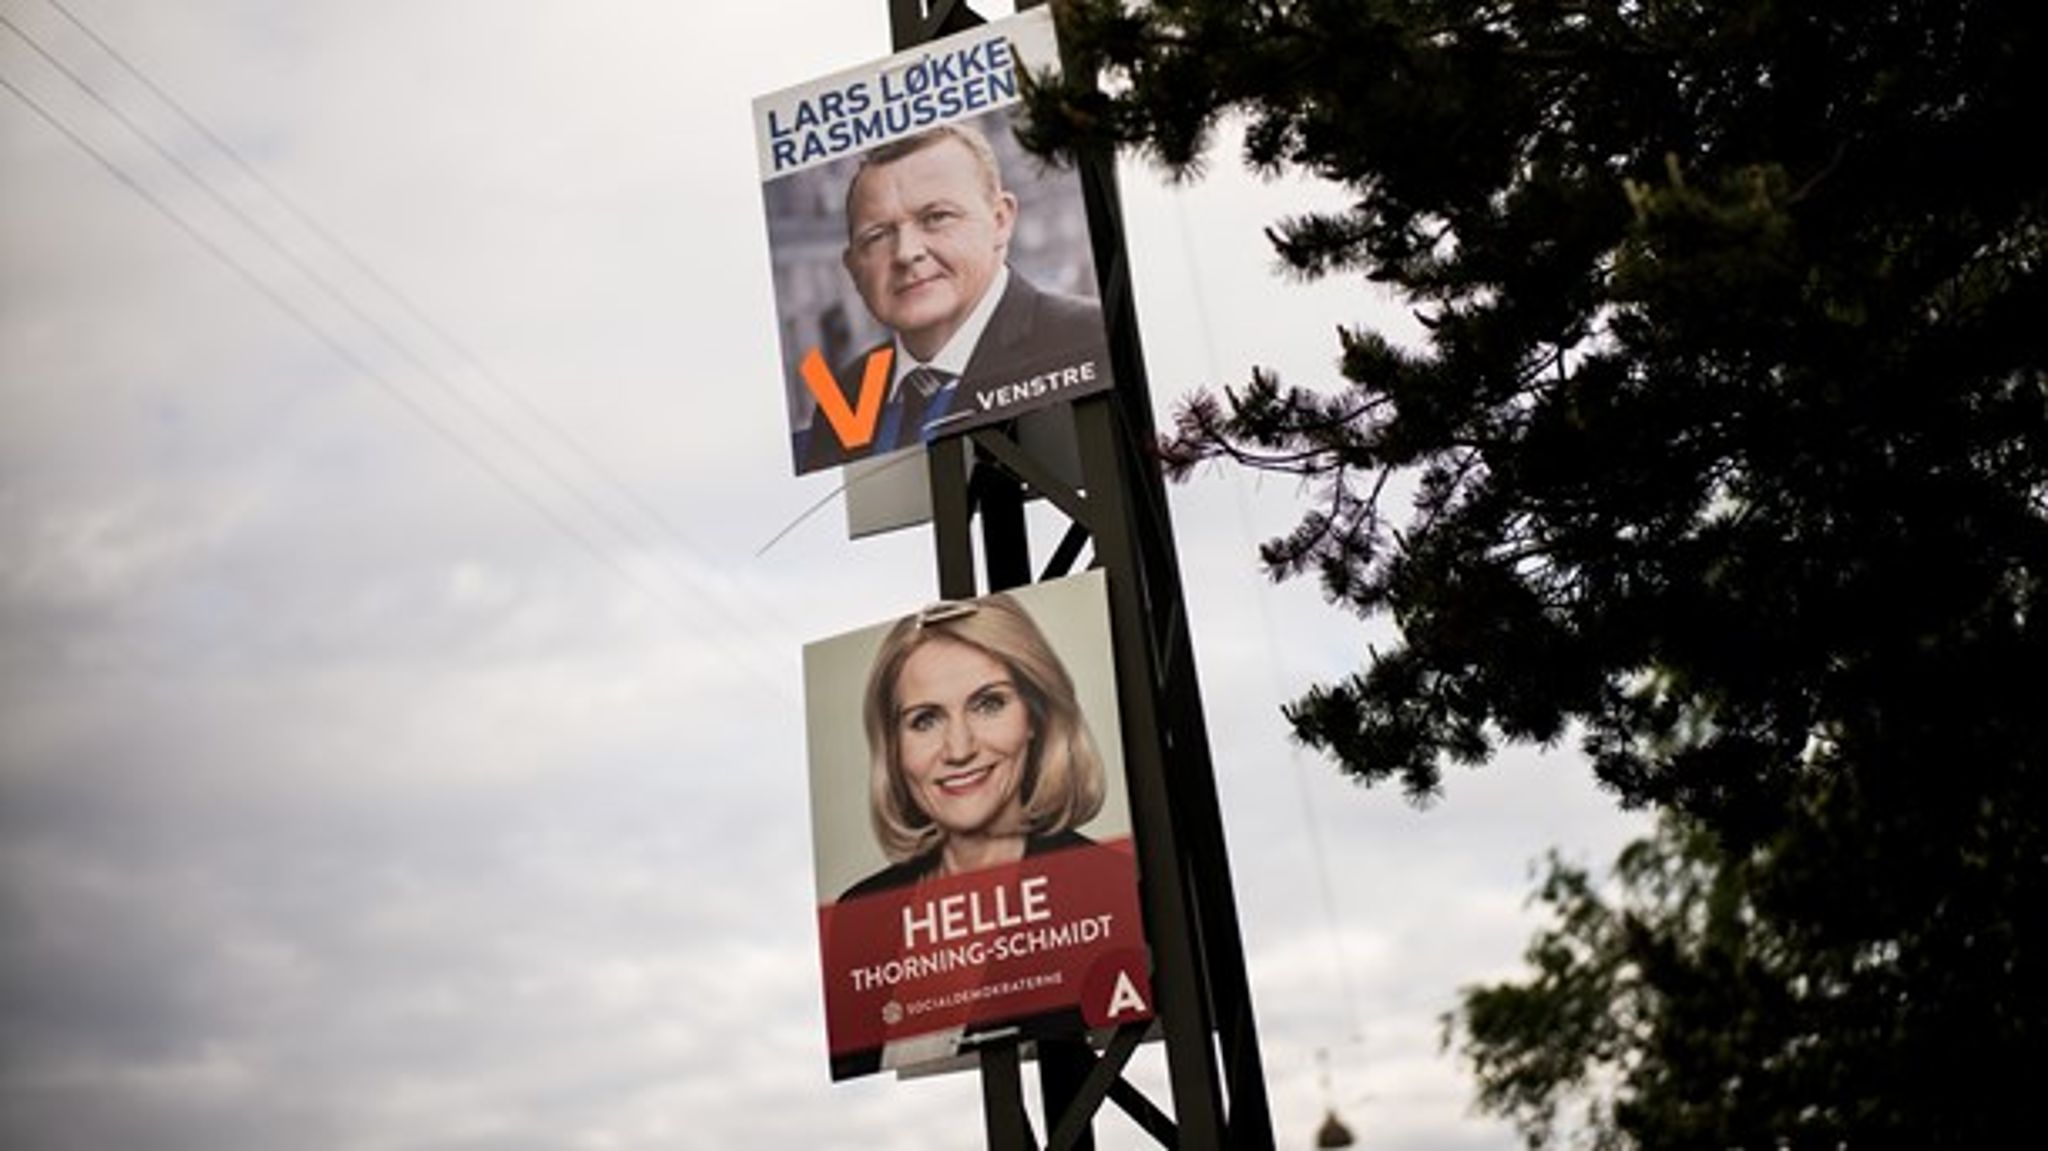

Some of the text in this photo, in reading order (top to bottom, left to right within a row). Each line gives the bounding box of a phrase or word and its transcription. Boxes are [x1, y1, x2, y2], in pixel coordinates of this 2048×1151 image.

[768, 36, 1010, 138] LARS LØKKE
[771, 69, 1018, 171] RASMUSSEN
[800, 345, 894, 448] V
[976, 361, 1096, 411] VENSTRE
[902, 876, 1051, 948] HELLE
[851, 915, 1113, 992] THORNING-SCHMIDT
[906, 972, 1064, 1015] SOCIALDEMOKRATERNE
[1107, 970, 1147, 1018] A
